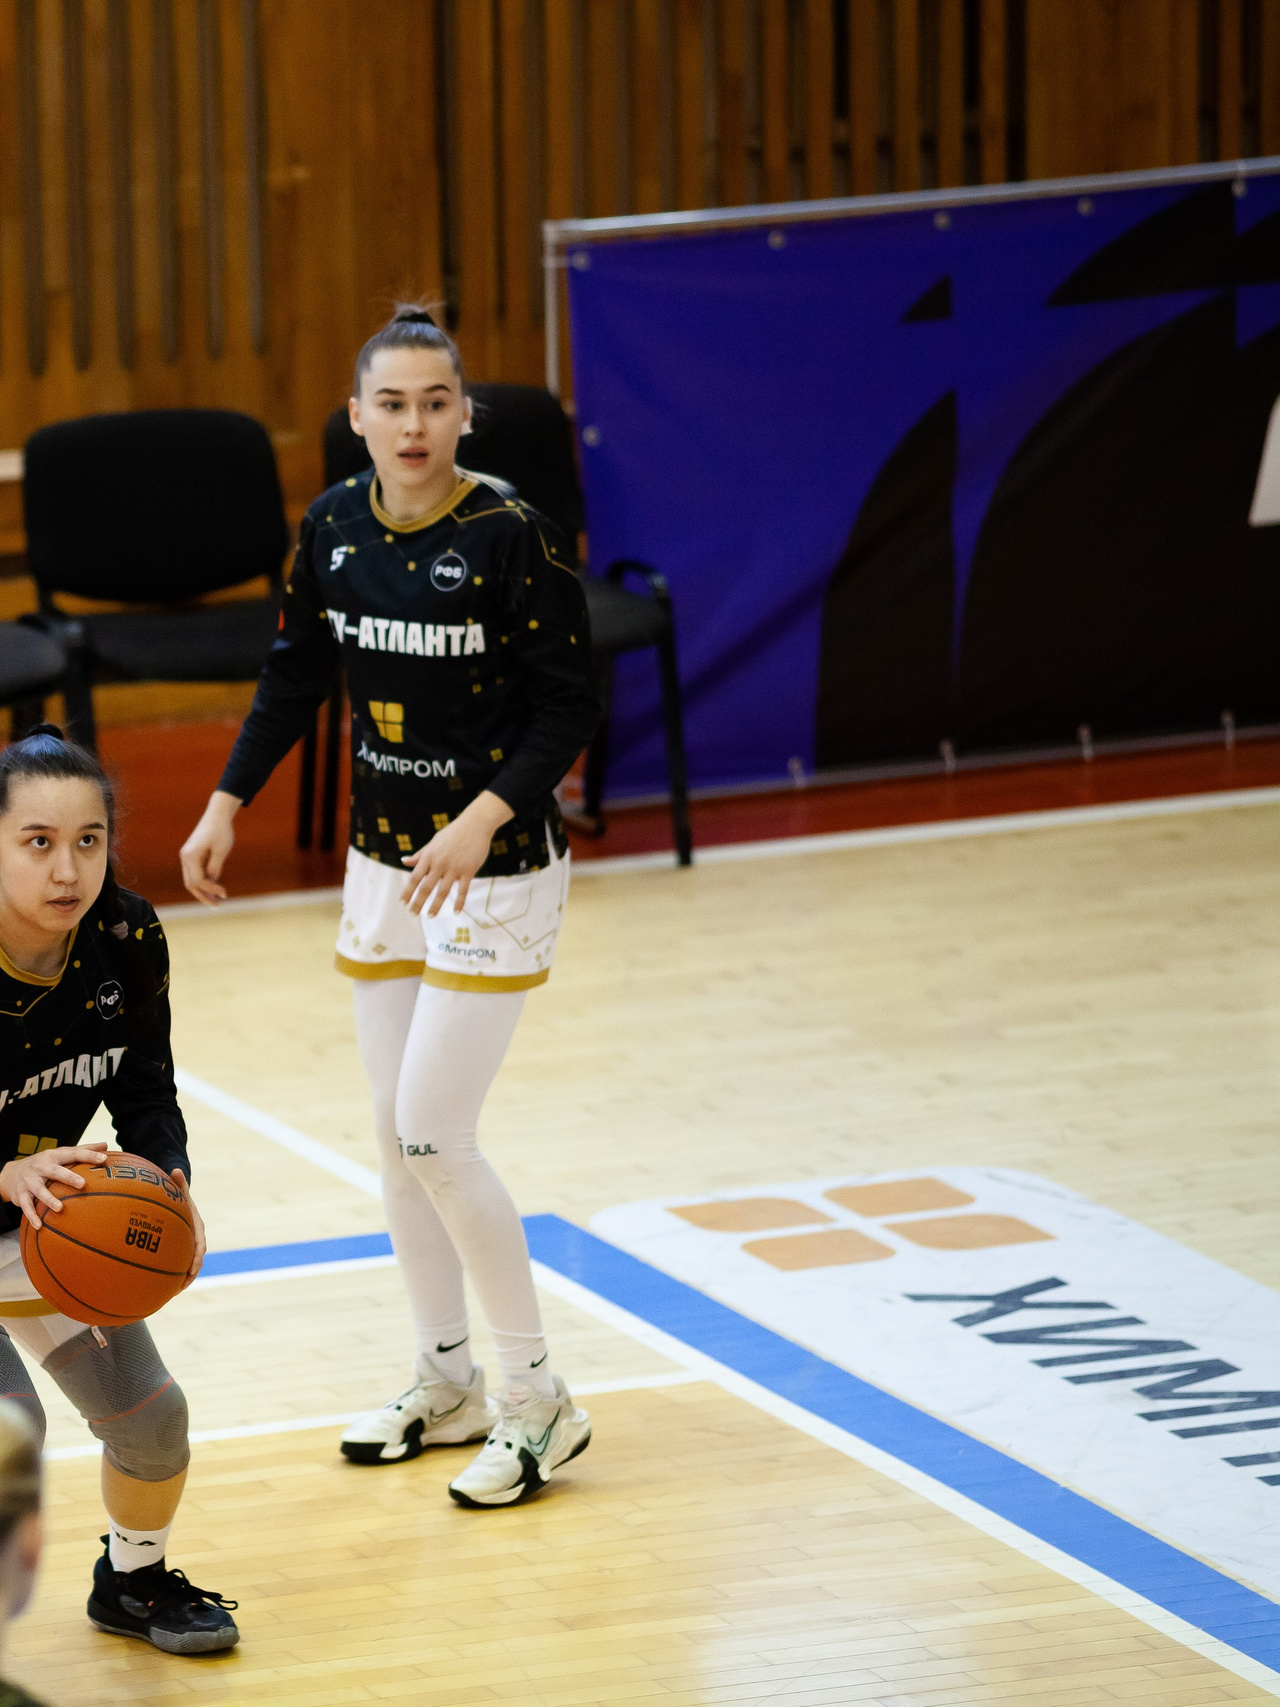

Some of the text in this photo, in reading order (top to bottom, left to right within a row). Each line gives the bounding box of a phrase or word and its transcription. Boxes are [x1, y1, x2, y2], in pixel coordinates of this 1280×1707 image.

[434, 564, 463, 580] РФБ
[326, 608, 486, 657] ГУ-АТЛАНТА
[406, 1143, 439, 1156] GUL
[129, 1217, 164, 1235] APPROVED
[124, 1227, 162, 1254] FIBA
[111, 1526, 158, 1547] ILA
